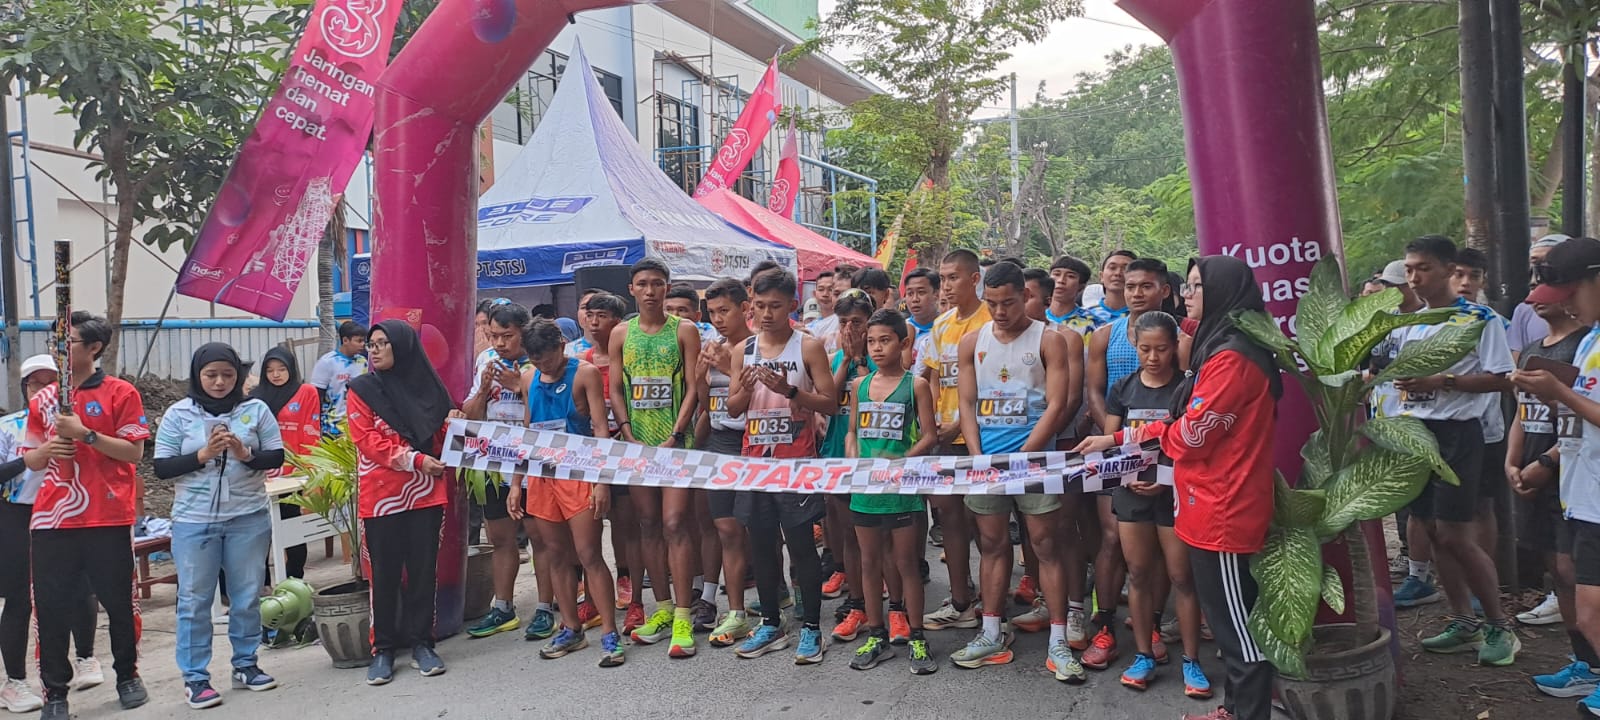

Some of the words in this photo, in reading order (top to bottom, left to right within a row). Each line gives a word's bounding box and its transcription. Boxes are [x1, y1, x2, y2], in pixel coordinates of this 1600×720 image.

[303, 48, 375, 98] Jaringan
[294, 64, 350, 107] hemat
[285, 87, 318, 113] dan
[275, 106, 327, 141] cepat.
[487, 199, 575, 215] BLUE
[573, 250, 618, 261] BLUE
[633, 385, 670, 400] U132
[981, 400, 1024, 415] U164
[750, 419, 789, 435] U035
[861, 412, 902, 429] U126
[711, 461, 852, 491] START
